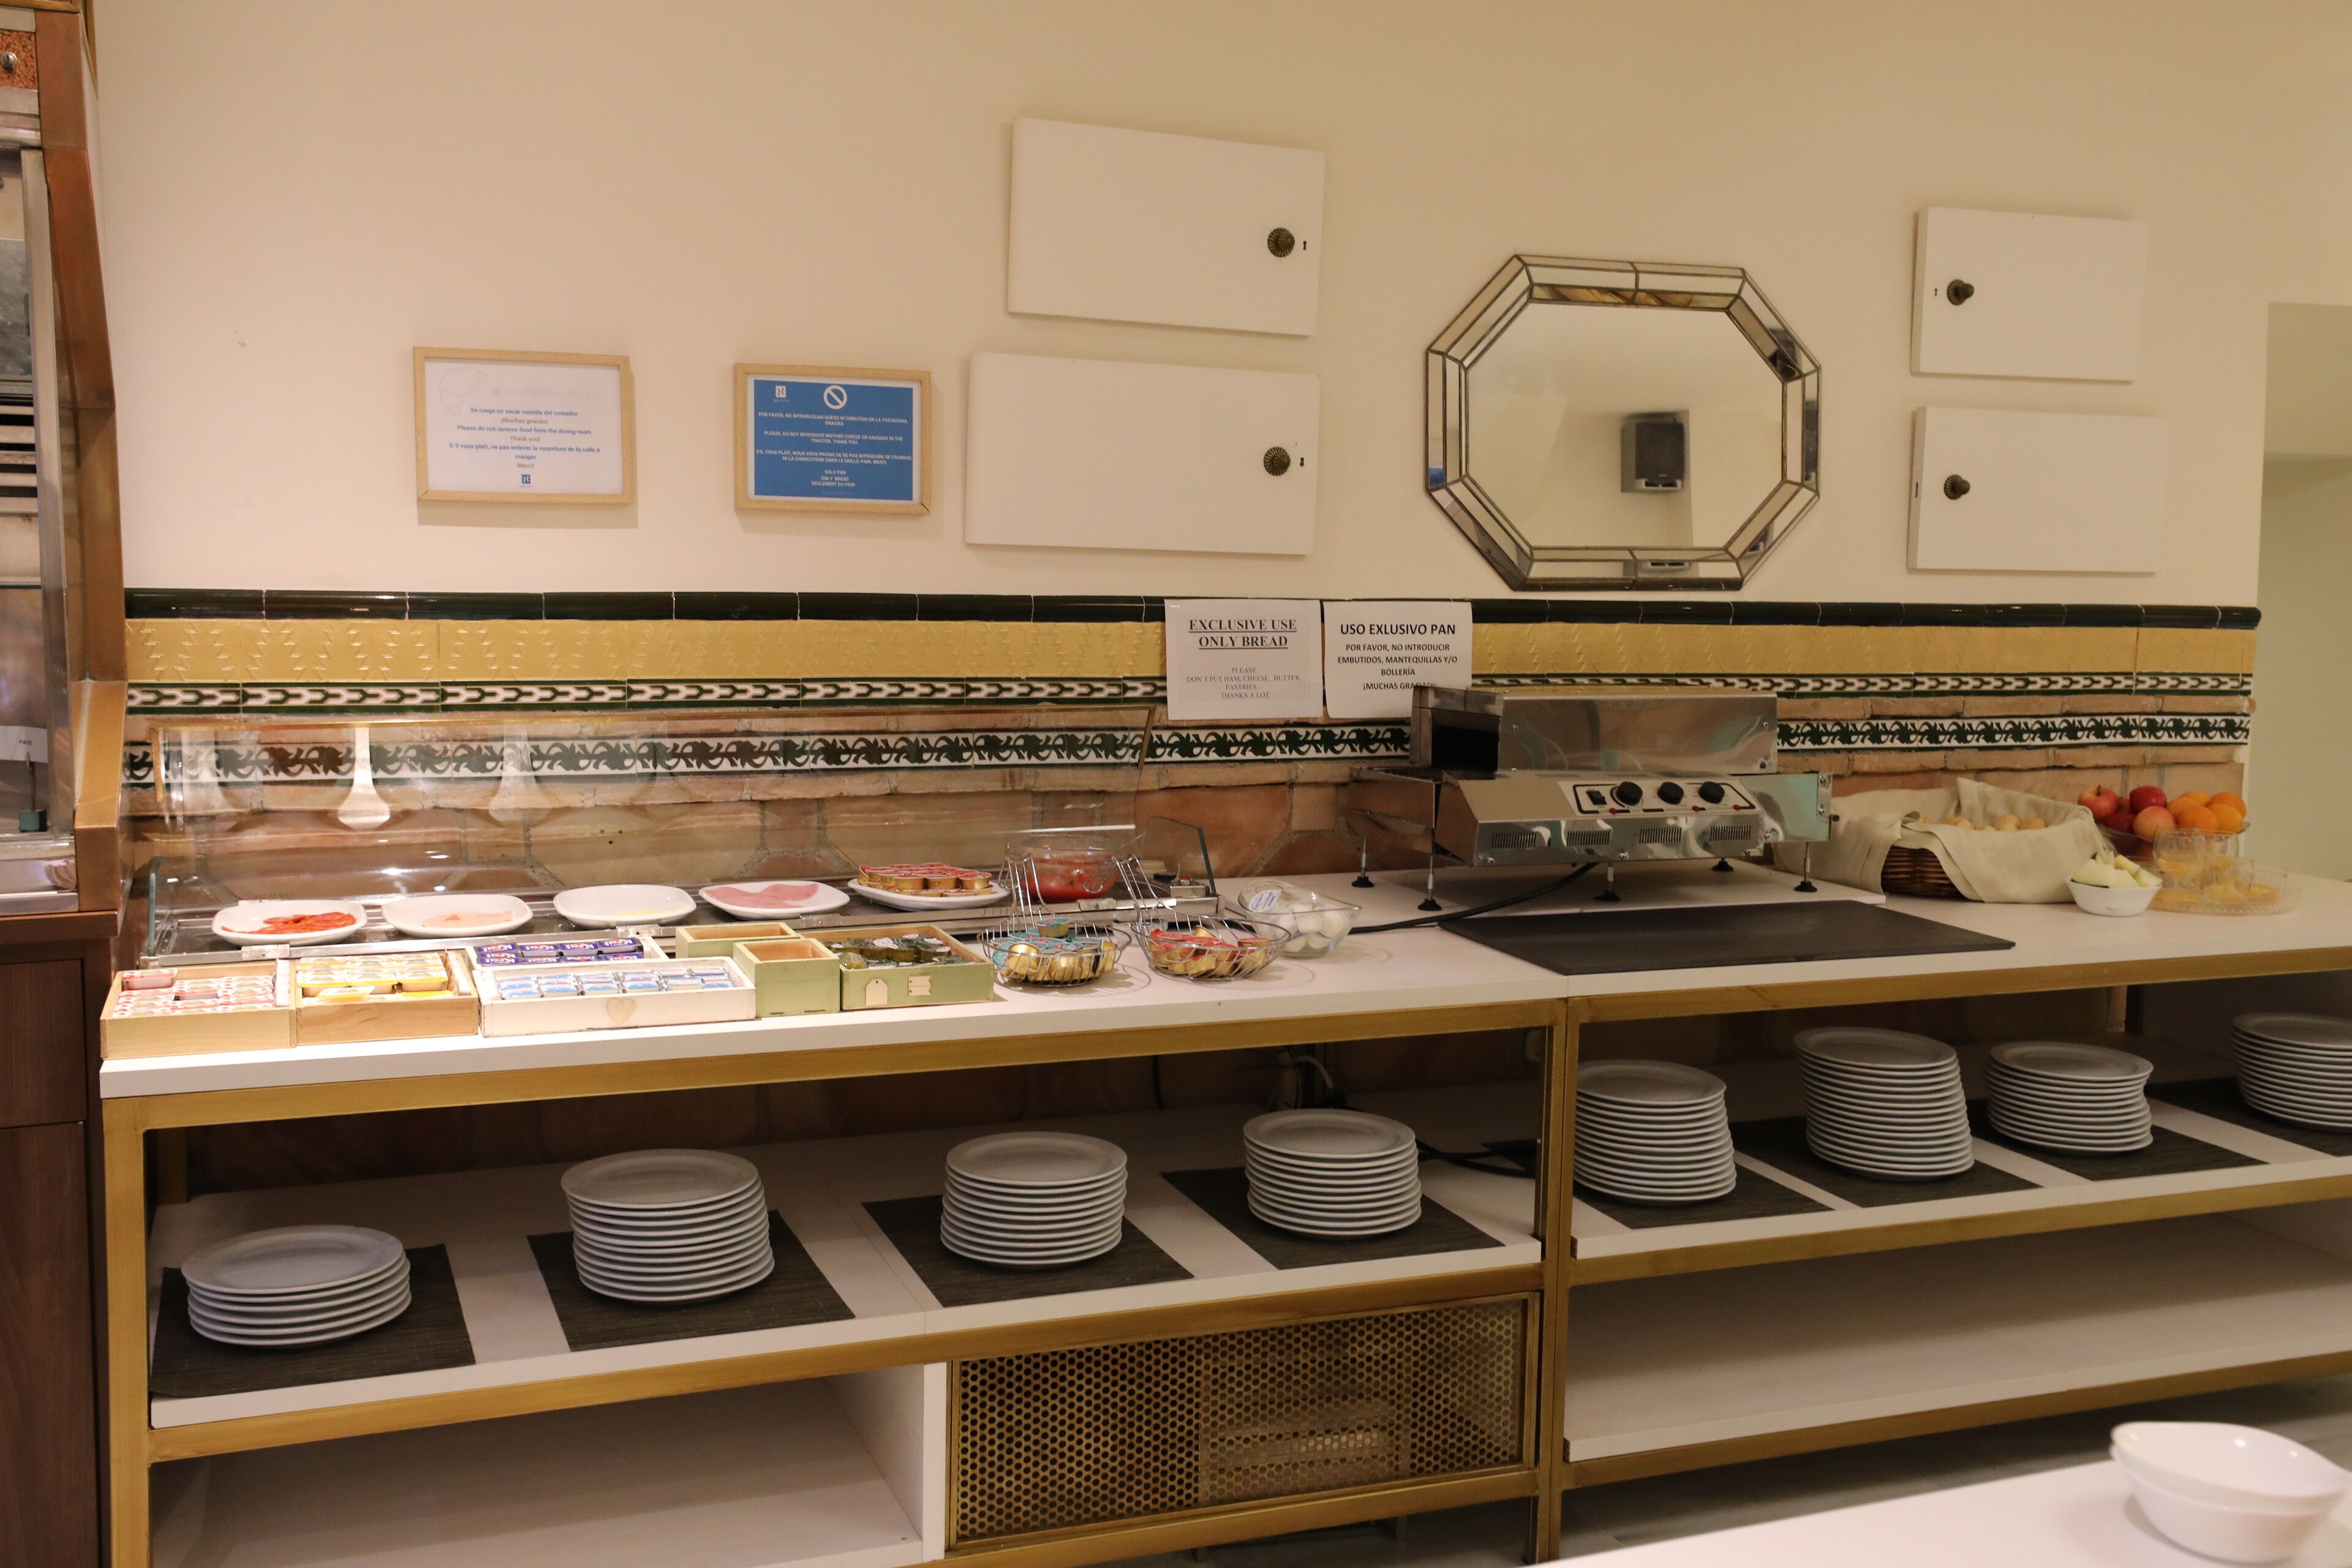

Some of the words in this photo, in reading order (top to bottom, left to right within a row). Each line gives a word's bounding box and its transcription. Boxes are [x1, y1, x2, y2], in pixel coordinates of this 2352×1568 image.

[1189, 619, 1267, 630] EXCLUSIVE
[1272, 619, 1297, 630] USE
[1341, 624, 1365, 635] USO
[1370, 624, 1427, 635] EXLUSIVO
[1431, 624, 1456, 635] PAN
[1199, 636, 1238, 647] ONLY
[1242, 636, 1287, 647] BREAD
[1338, 656, 1383, 665] EMBUTIDOS,
